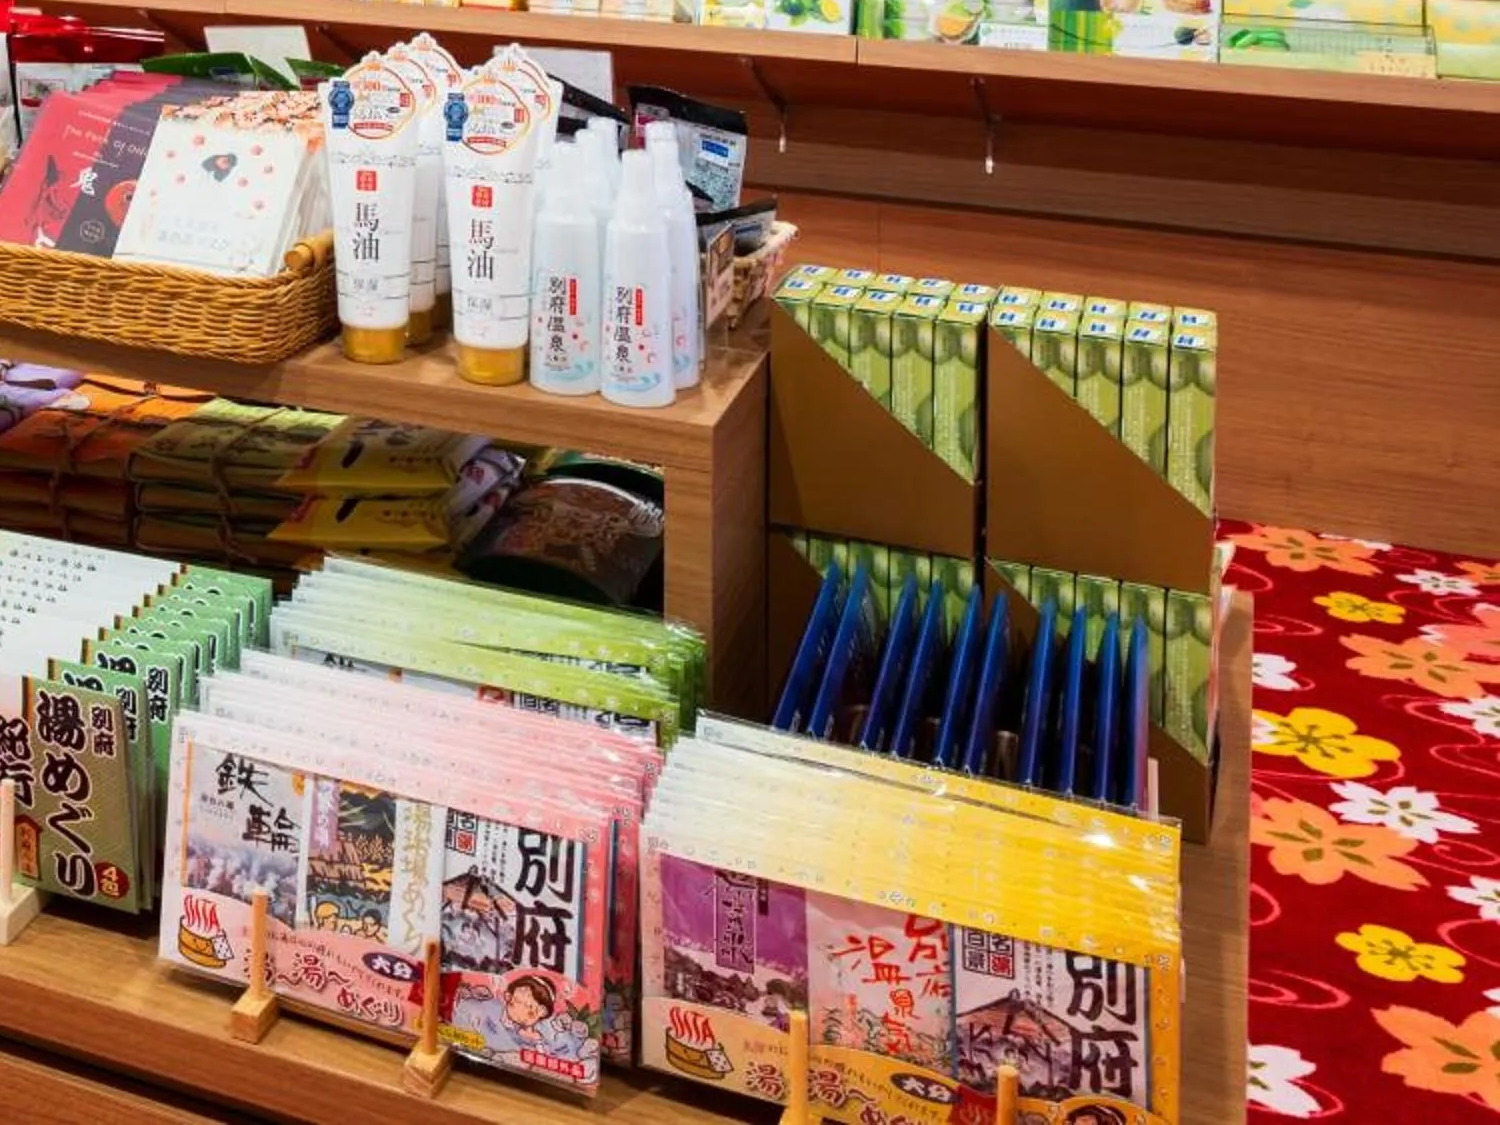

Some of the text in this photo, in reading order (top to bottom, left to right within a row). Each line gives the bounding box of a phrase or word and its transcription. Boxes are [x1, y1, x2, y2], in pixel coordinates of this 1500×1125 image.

[354, 201, 381, 263] 馬油
[469, 218, 496, 282] 馬油
[149, 666, 169, 722] 別府
[90, 704, 116, 759] 別府
[37, 689, 98, 898] 湯めぐり
[515, 824, 576, 973] 別府
[1066, 949, 1140, 1099] 別府
